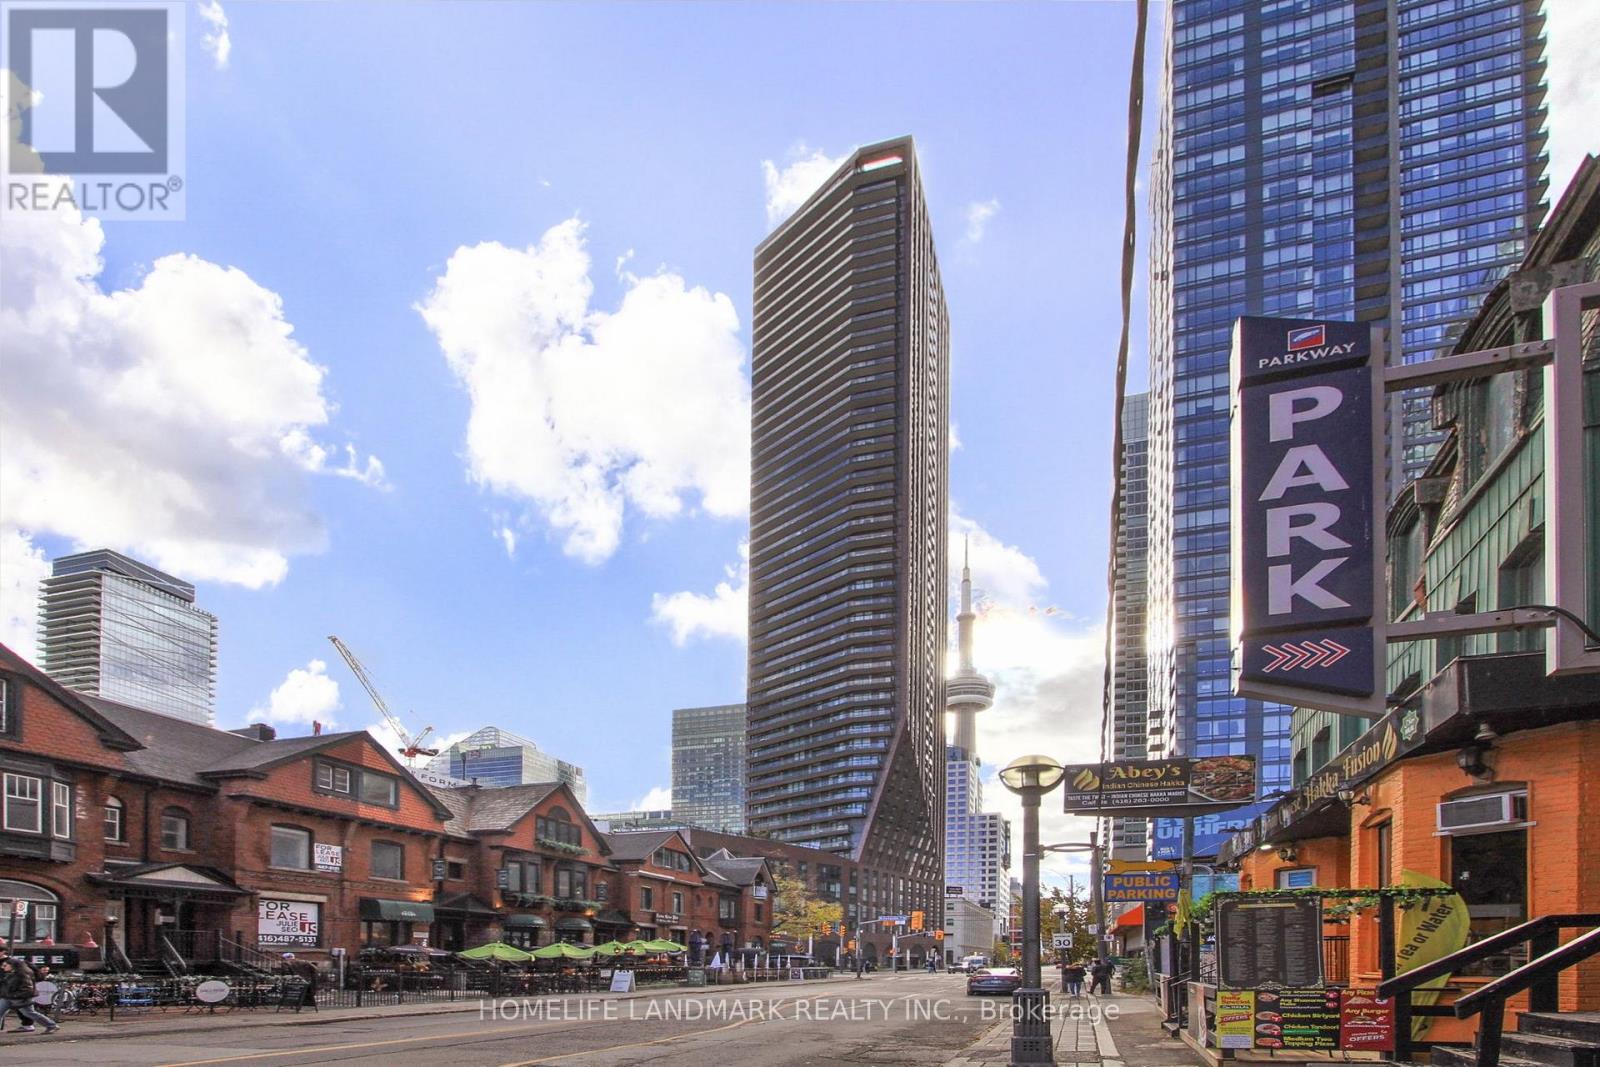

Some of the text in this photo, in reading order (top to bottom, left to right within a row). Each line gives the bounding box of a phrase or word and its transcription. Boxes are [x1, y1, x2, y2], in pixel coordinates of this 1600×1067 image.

[1258, 341, 1356, 369] PARKWAY
[1258, 385, 1352, 616] PARK
[1107, 764, 1181, 781] Abey's
[1303, 740, 1381, 809] Hakka Fusion
[1127, 781, 1158, 789] Chinese
[1112, 876, 1171, 887] PUBLIC
[1107, 888, 1176, 899] PARKING
[1416, 903, 1454, 933] Water
[1413, 933, 1430, 944] or
[1349, 1034, 1385, 1042] OFFERS
